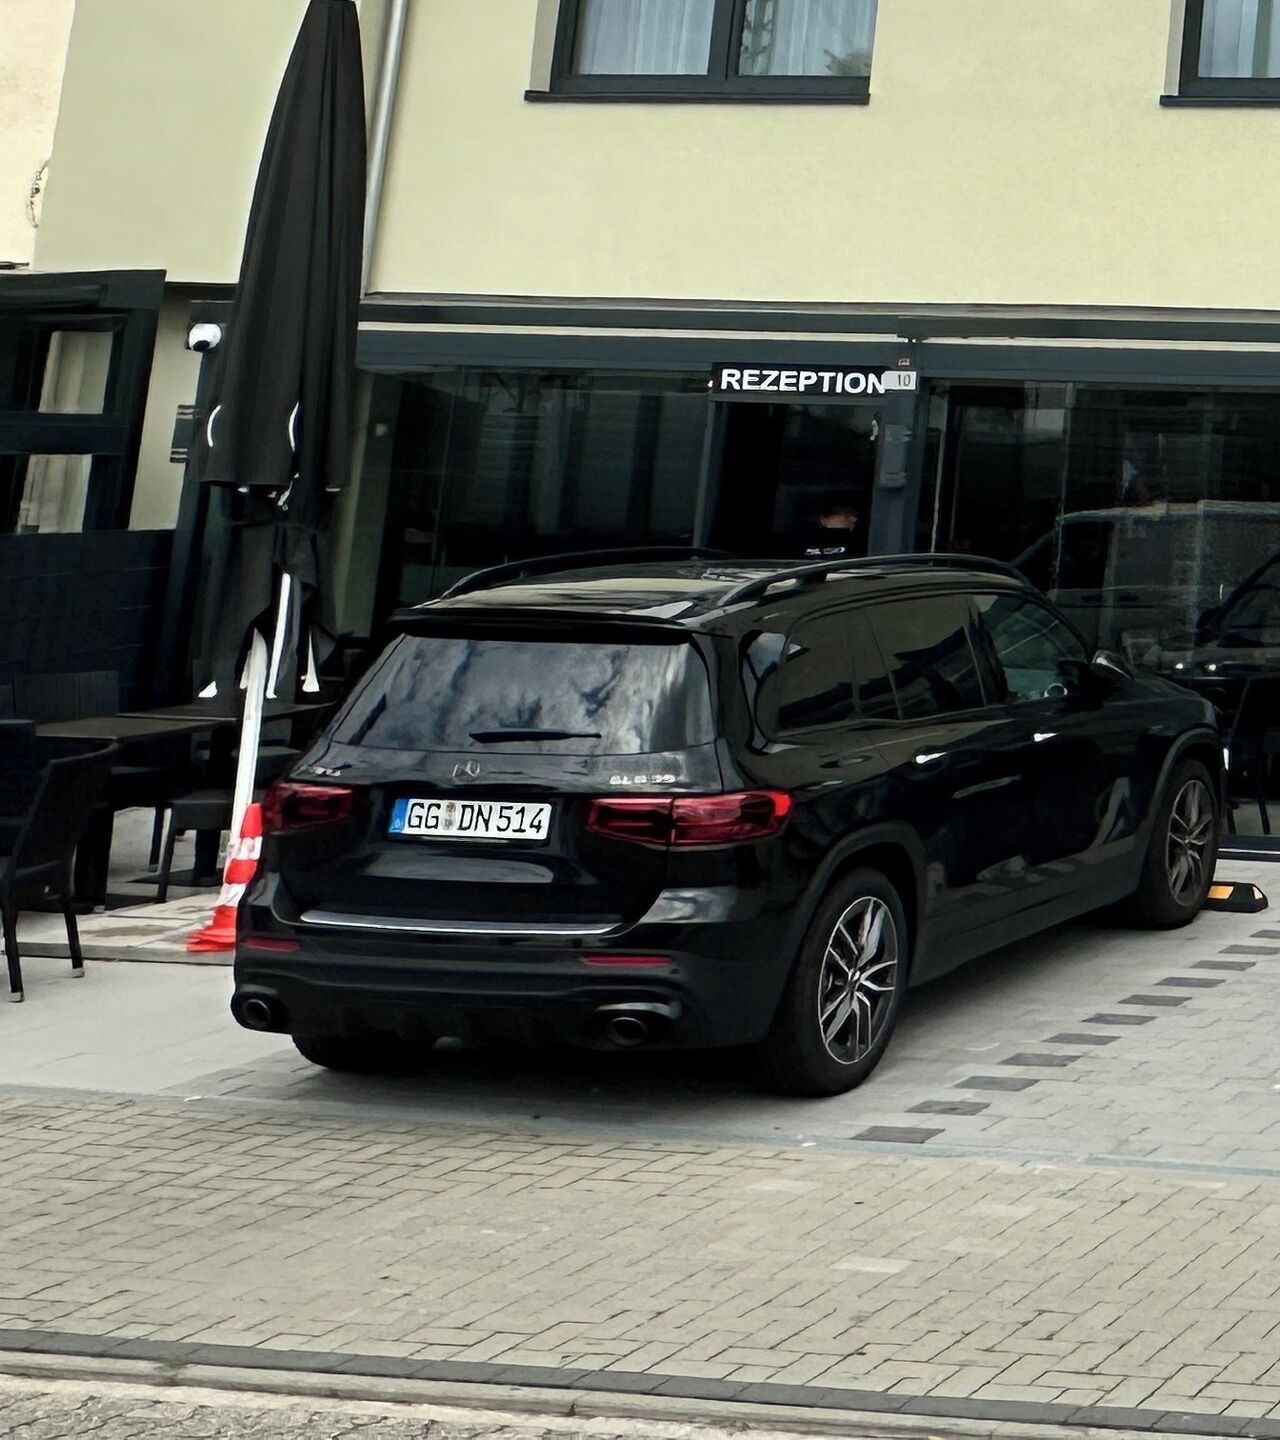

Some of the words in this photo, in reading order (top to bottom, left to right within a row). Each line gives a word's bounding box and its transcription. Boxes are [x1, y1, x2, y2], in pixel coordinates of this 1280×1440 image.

[720, 368, 886, 394] REZEPTION
[896, 373, 911, 387] 10
[407, 802, 441, 830] GG
[457, 803, 493, 832] DN
[496, 804, 544, 833] 514
